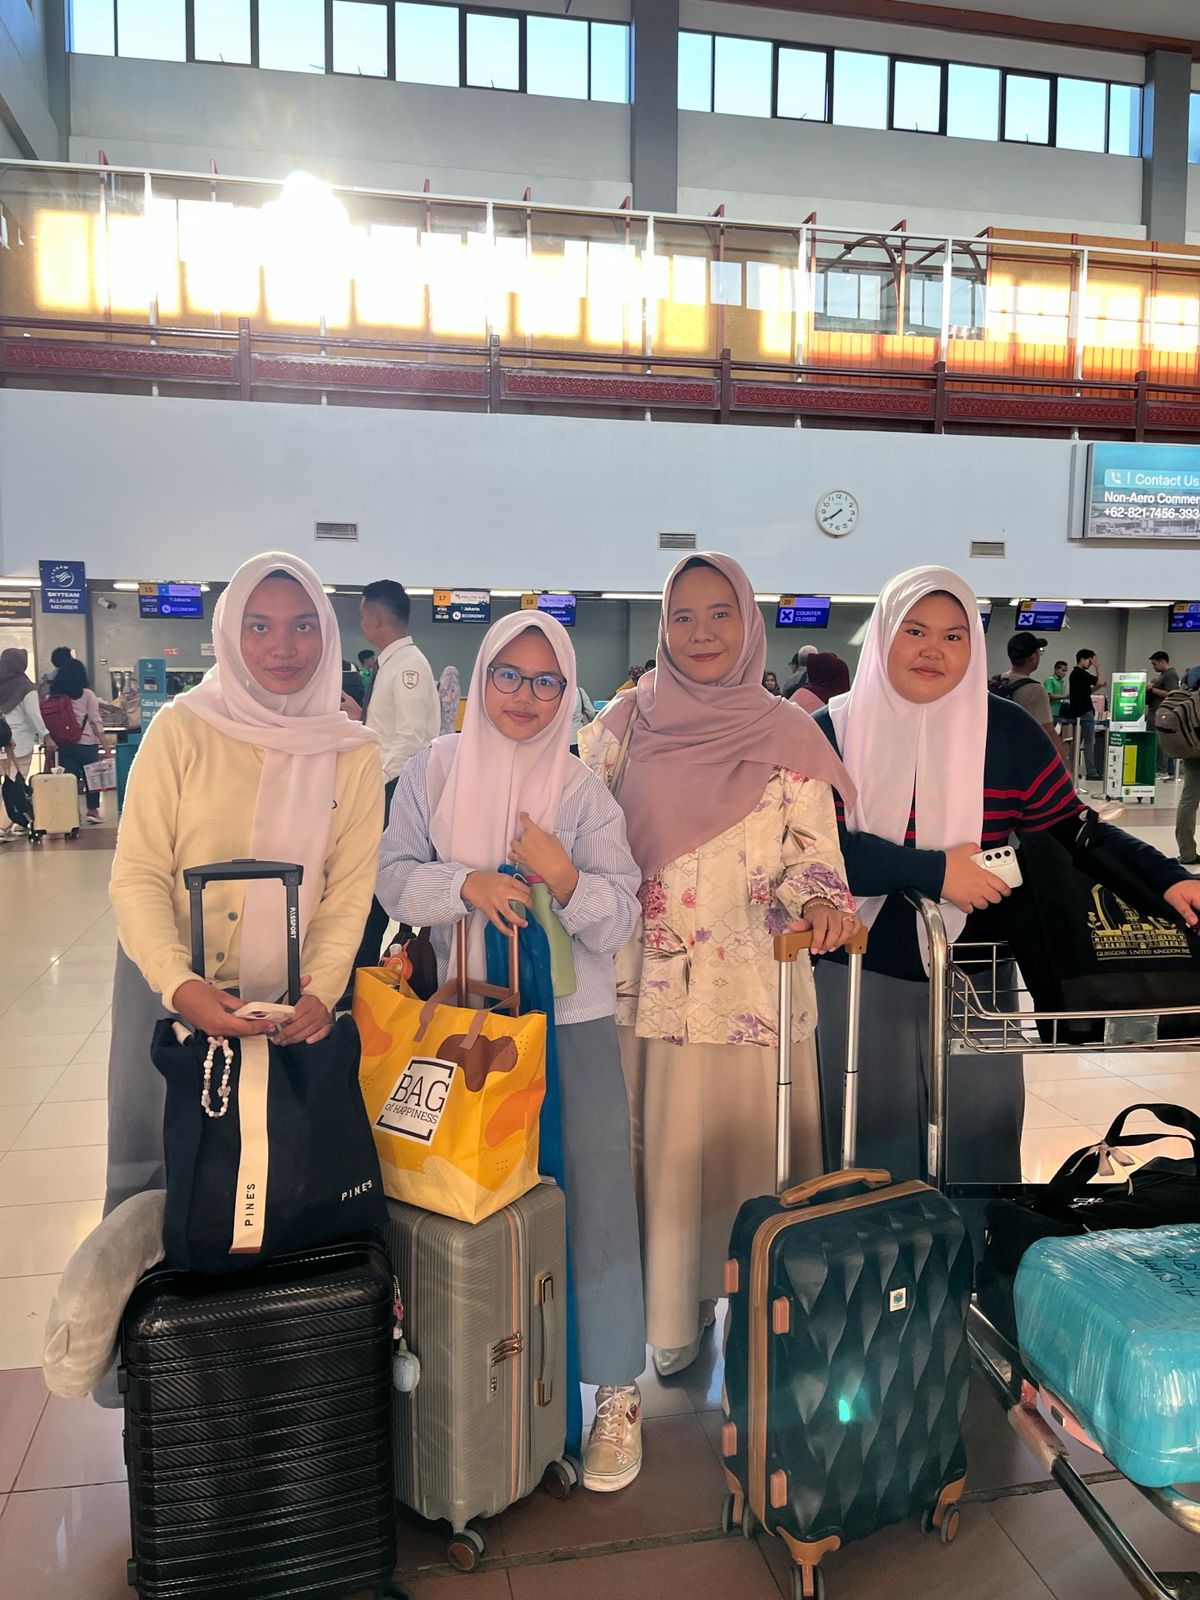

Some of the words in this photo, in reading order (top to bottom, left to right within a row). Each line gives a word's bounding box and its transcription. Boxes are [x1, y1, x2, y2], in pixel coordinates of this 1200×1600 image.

[1135, 473, 1182, 486] Contact
[1184, 474, 1200, 486] Us
[1104, 491, 1155, 503] Non-Aero
[1104, 507, 1200, 519] +62-821-7456-393
[1096, 949, 1127, 957] GLASGOW
[1129, 948, 1152, 956] UNITED
[1153, 947, 1181, 955] KINGDOM
[390, 1073, 450, 1114] BAG
[393, 1104, 439, 1125] HAPPINESS
[244, 1183, 256, 1227] PINE'S
